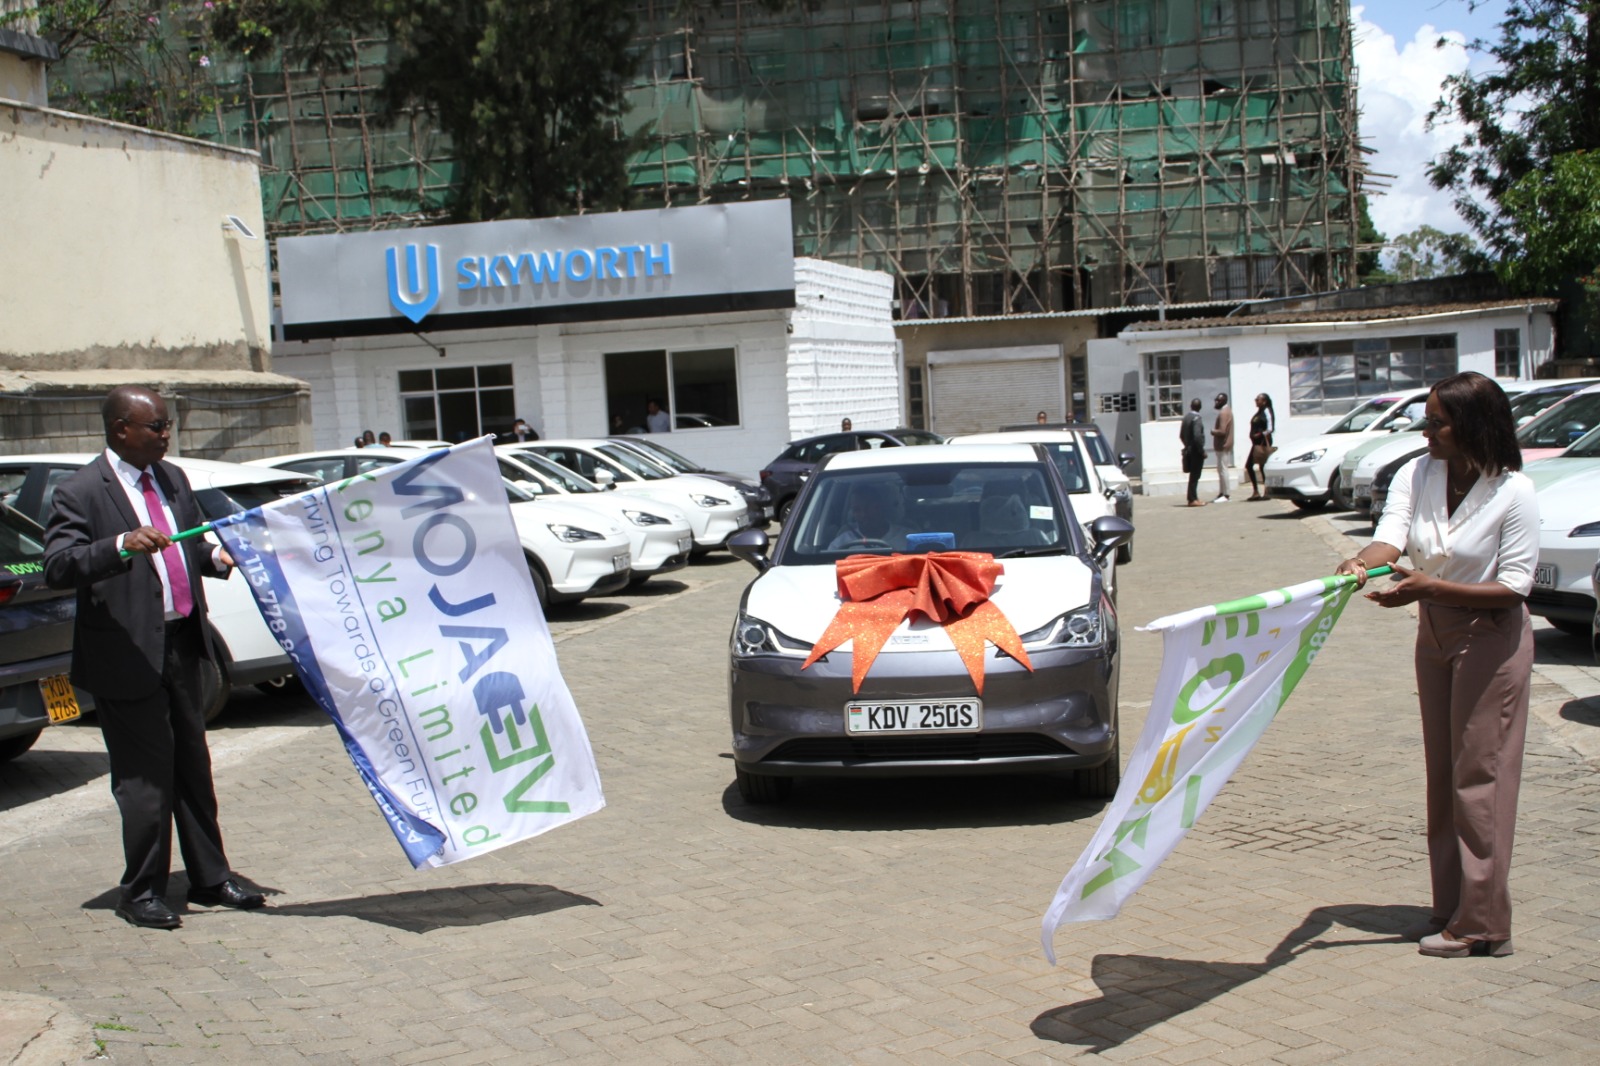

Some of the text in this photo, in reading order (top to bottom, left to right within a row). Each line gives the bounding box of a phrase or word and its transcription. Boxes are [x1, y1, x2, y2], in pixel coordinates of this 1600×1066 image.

[456, 242, 672, 290] SKYWORTH
[4, 562, 44, 576] 100%
[244, 552, 271, 588] 113
[260, 588, 288, 634] 778
[302, 493, 335, 563] riving
[327, 564, 376, 673] Towards
[369, 677, 386, 695] a
[378, 699, 416, 774] Green
[49, 676, 70, 699] KDV
[50, 698, 78, 721] 176S
[868, 704, 973, 730] KDV 250S
[397, 649, 500, 847] Limited
